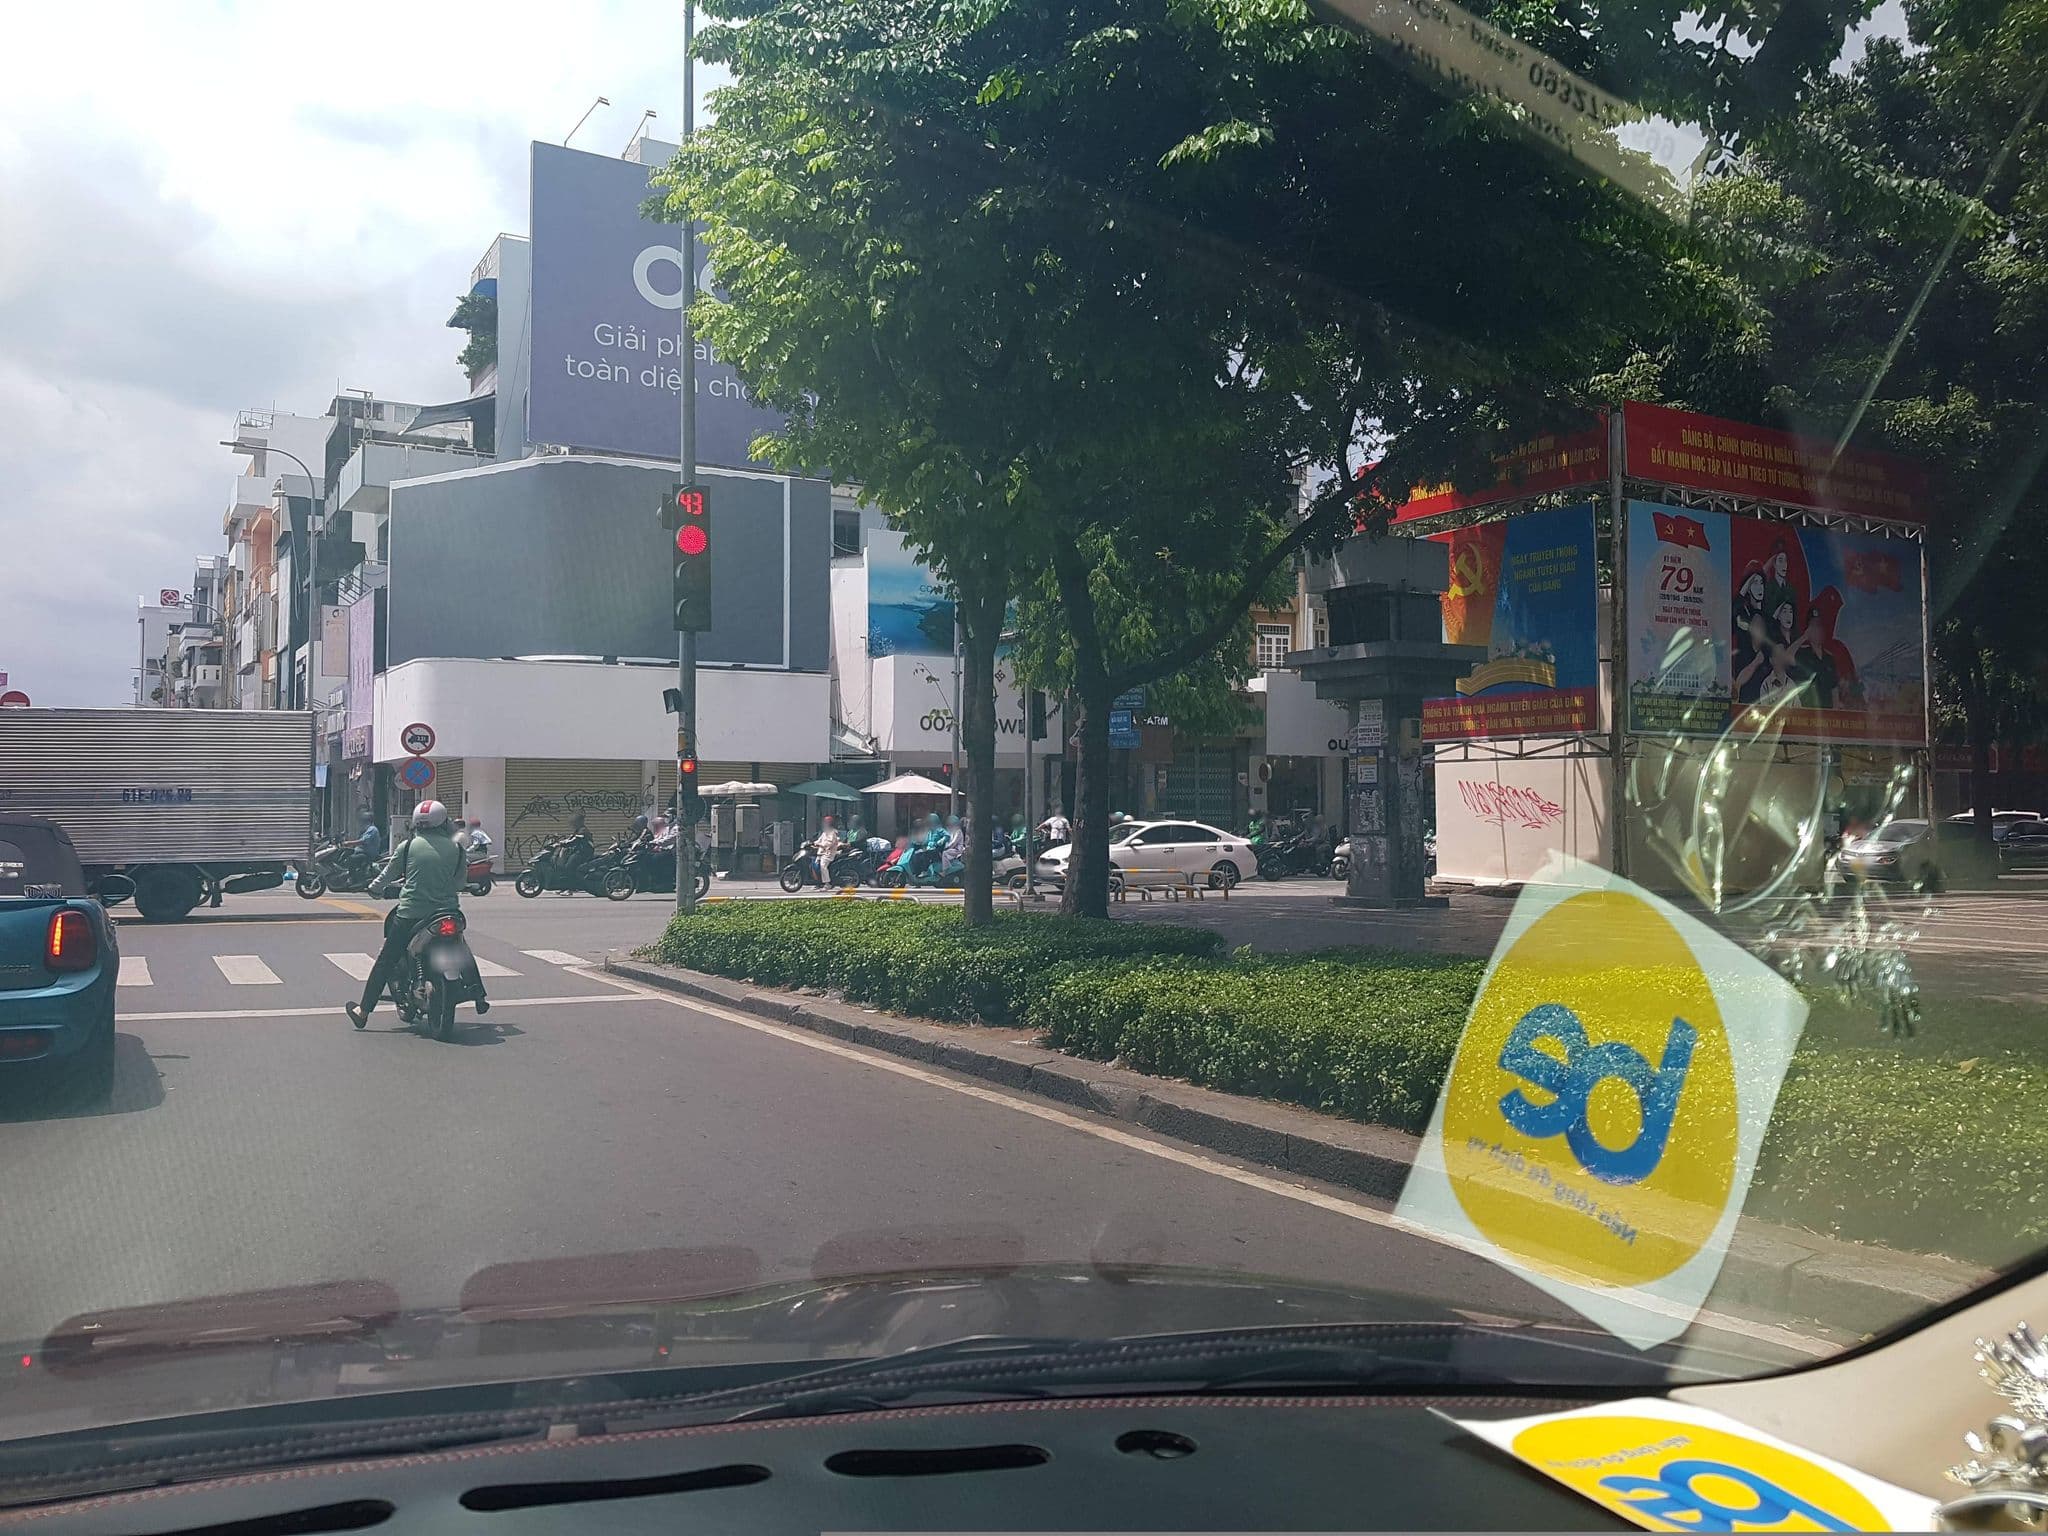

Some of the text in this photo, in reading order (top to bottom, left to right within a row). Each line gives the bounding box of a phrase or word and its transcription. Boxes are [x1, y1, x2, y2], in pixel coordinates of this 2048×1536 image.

[594, 323, 646, 352] Giải
[564, 354, 630, 385] toàn
[640, 363, 698, 395] diệ
[680, 492, 703, 515] 43
[1661, 565, 1694, 592] 79
